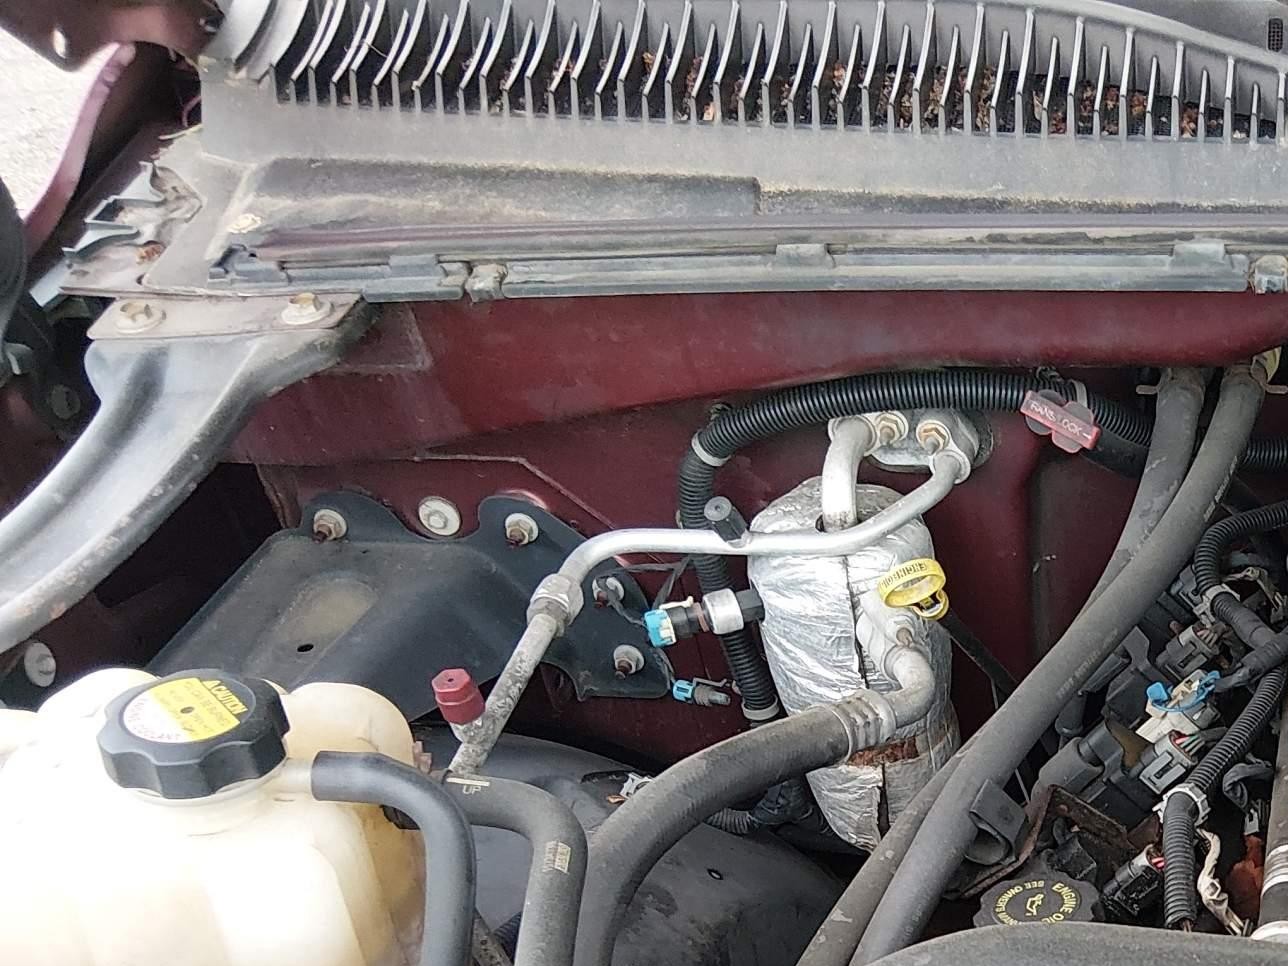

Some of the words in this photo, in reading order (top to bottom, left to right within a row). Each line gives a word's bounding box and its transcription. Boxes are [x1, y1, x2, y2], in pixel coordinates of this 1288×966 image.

[462, 784, 481, 795] UP
[1051, 882, 1078, 914] ENGINE
[1041, 912, 1065, 924] OIL
